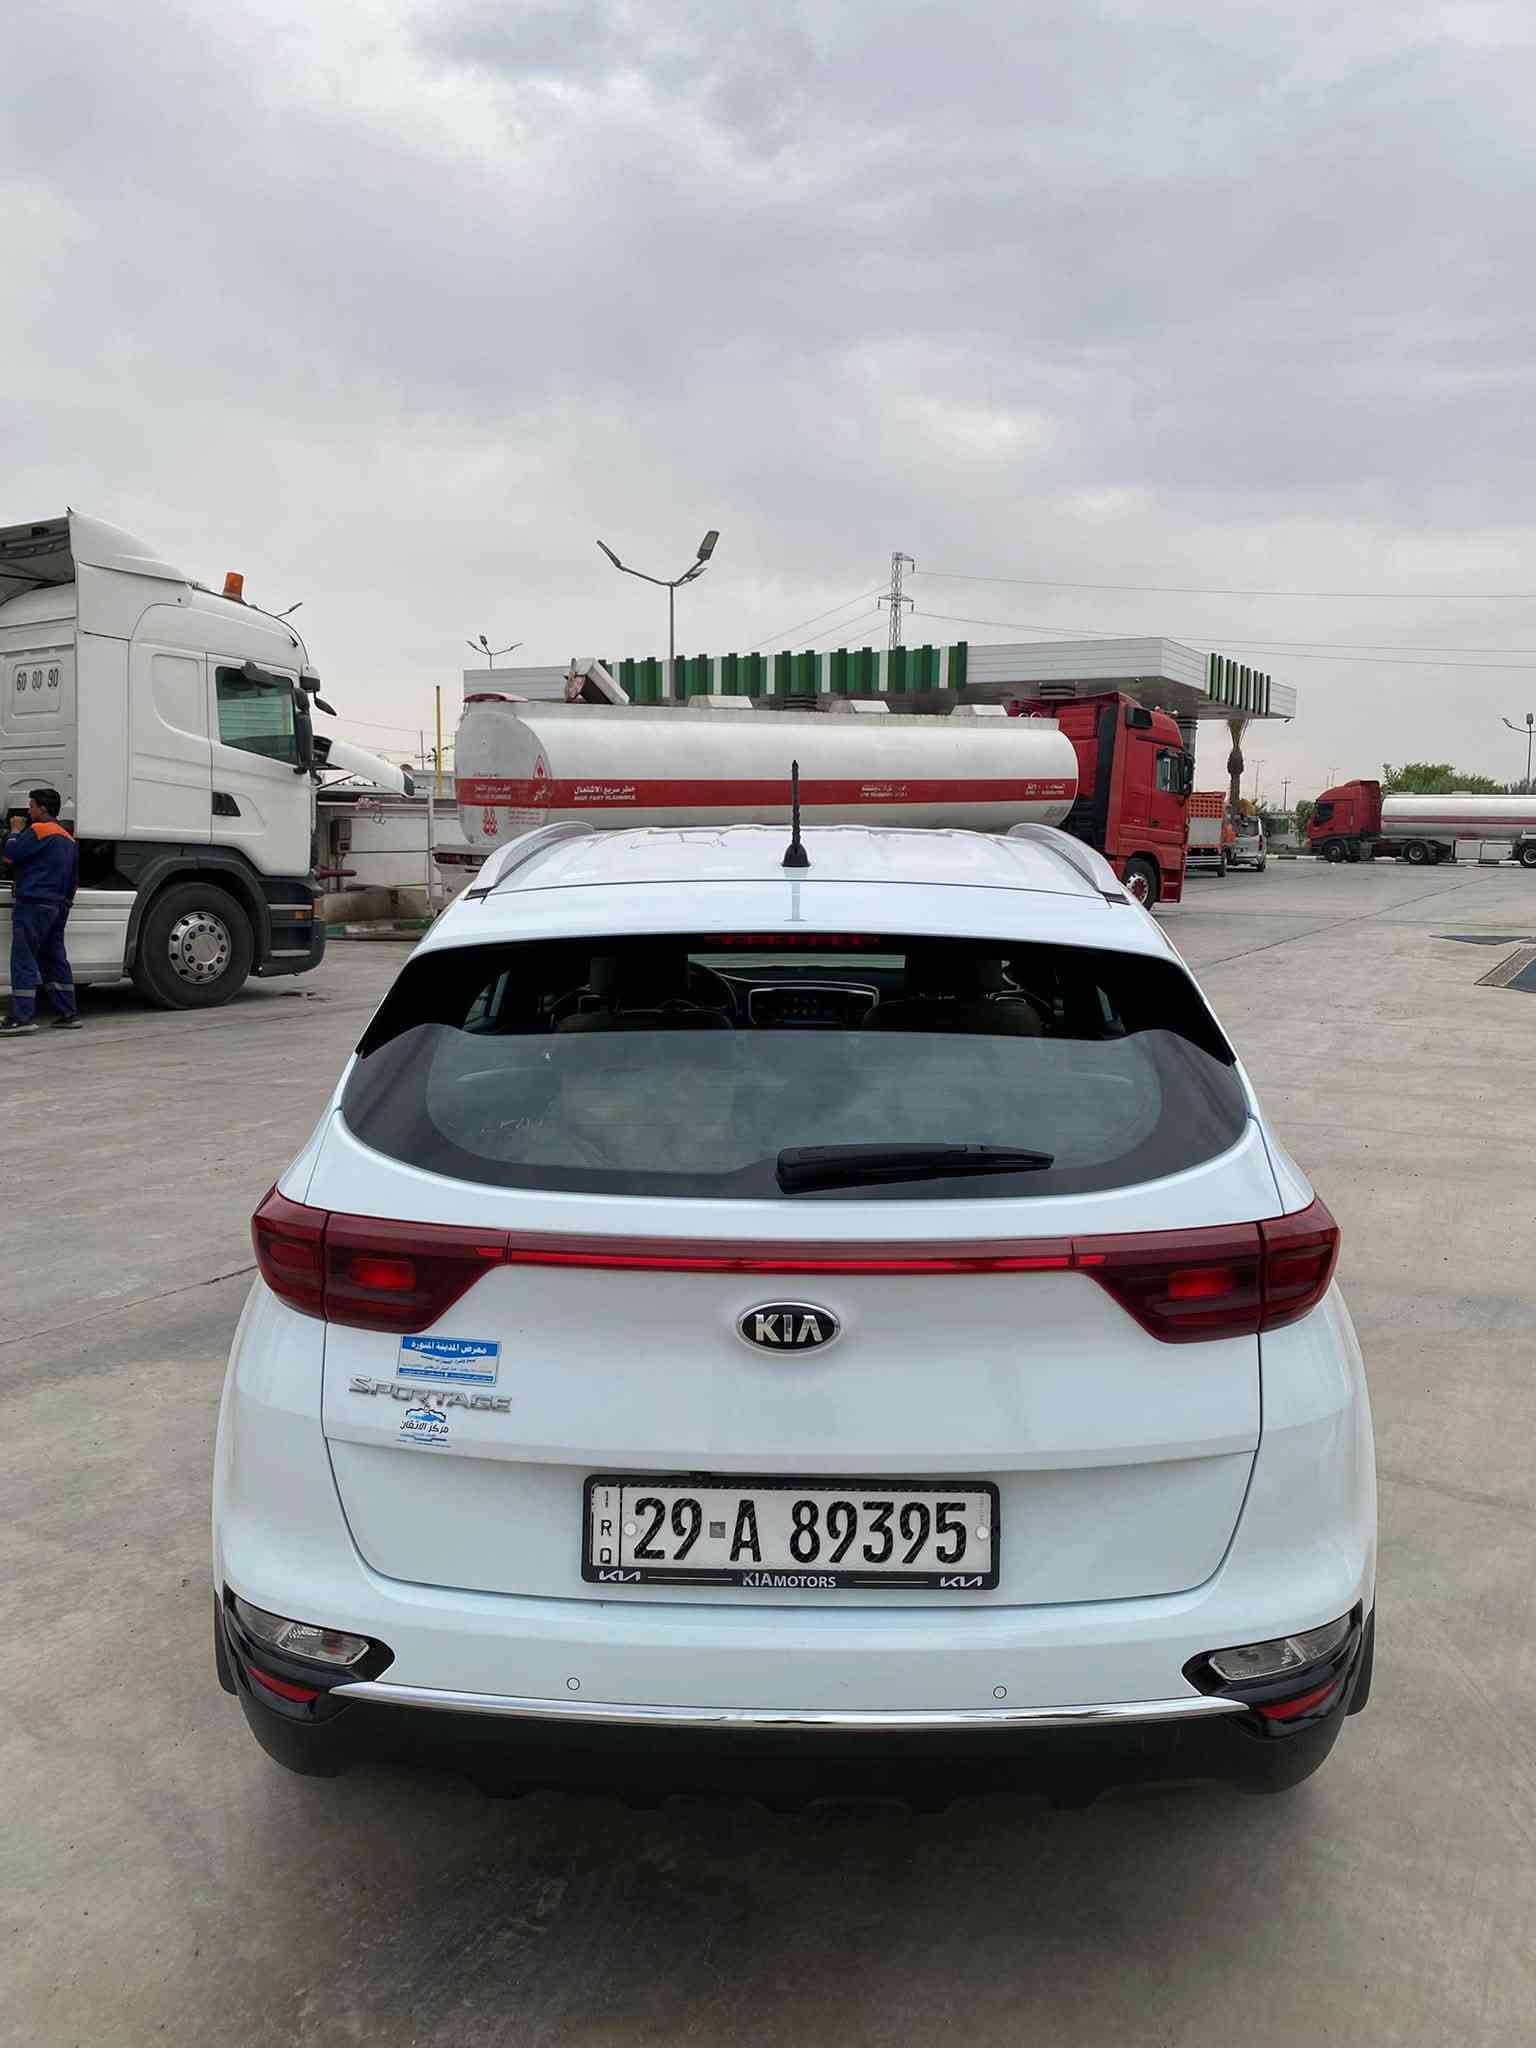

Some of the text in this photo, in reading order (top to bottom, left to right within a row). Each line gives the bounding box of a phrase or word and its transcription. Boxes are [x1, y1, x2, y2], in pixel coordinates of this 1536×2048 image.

[754, 1313, 824, 1343] KIA
[461, 1344, 488, 1354] معرض
[349, 1376, 513, 1414] SPORTAGE
[428, 1423, 449, 1434] مركز
[634, 1497, 702, 1561] 29
[730, 1500, 762, 1562] A
[789, 1499, 967, 1564] 89395
